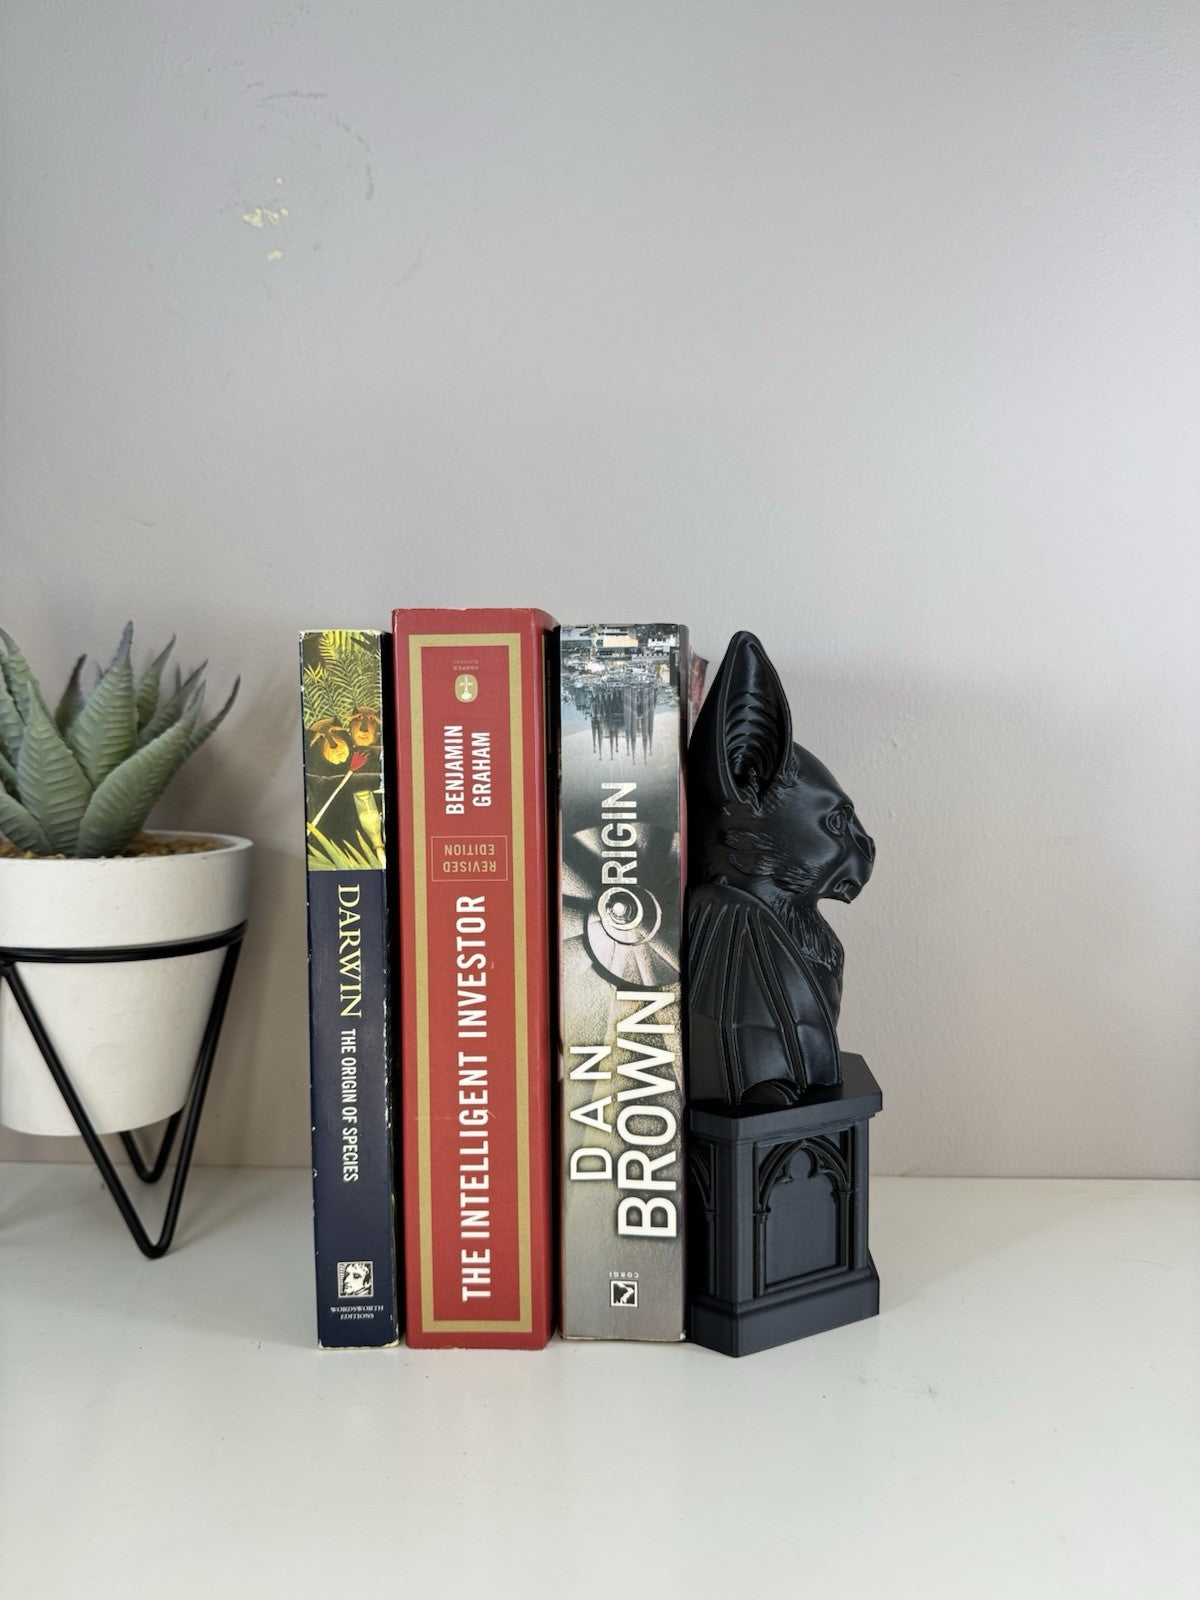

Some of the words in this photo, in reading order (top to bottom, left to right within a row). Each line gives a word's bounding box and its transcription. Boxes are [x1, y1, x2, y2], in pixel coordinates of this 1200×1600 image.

[444, 725, 464, 815] BENJAMIN
[471, 732, 491, 807] GRAHAM
[443, 860, 497, 873] REVISED
[444, 844, 495, 856] EDITION
[597, 782, 643, 931] ORIGIN
[338, 884, 362, 1018] DARWIN
[456, 895, 487, 1038] INVESTOR
[340, 1028, 356, 1054] THE
[341, 1057, 357, 1103] ORIGIN
[342, 1106, 358, 1124] OF
[458, 1051, 490, 1239] INTELLIGENT
[569, 1045, 613, 1181] DAN
[616, 991, 677, 1238] BROWN
[342, 1127, 359, 1183] SPECIES
[461, 1249, 491, 1302] THE
[330, 1305, 384, 1313] WORDSWORTH
